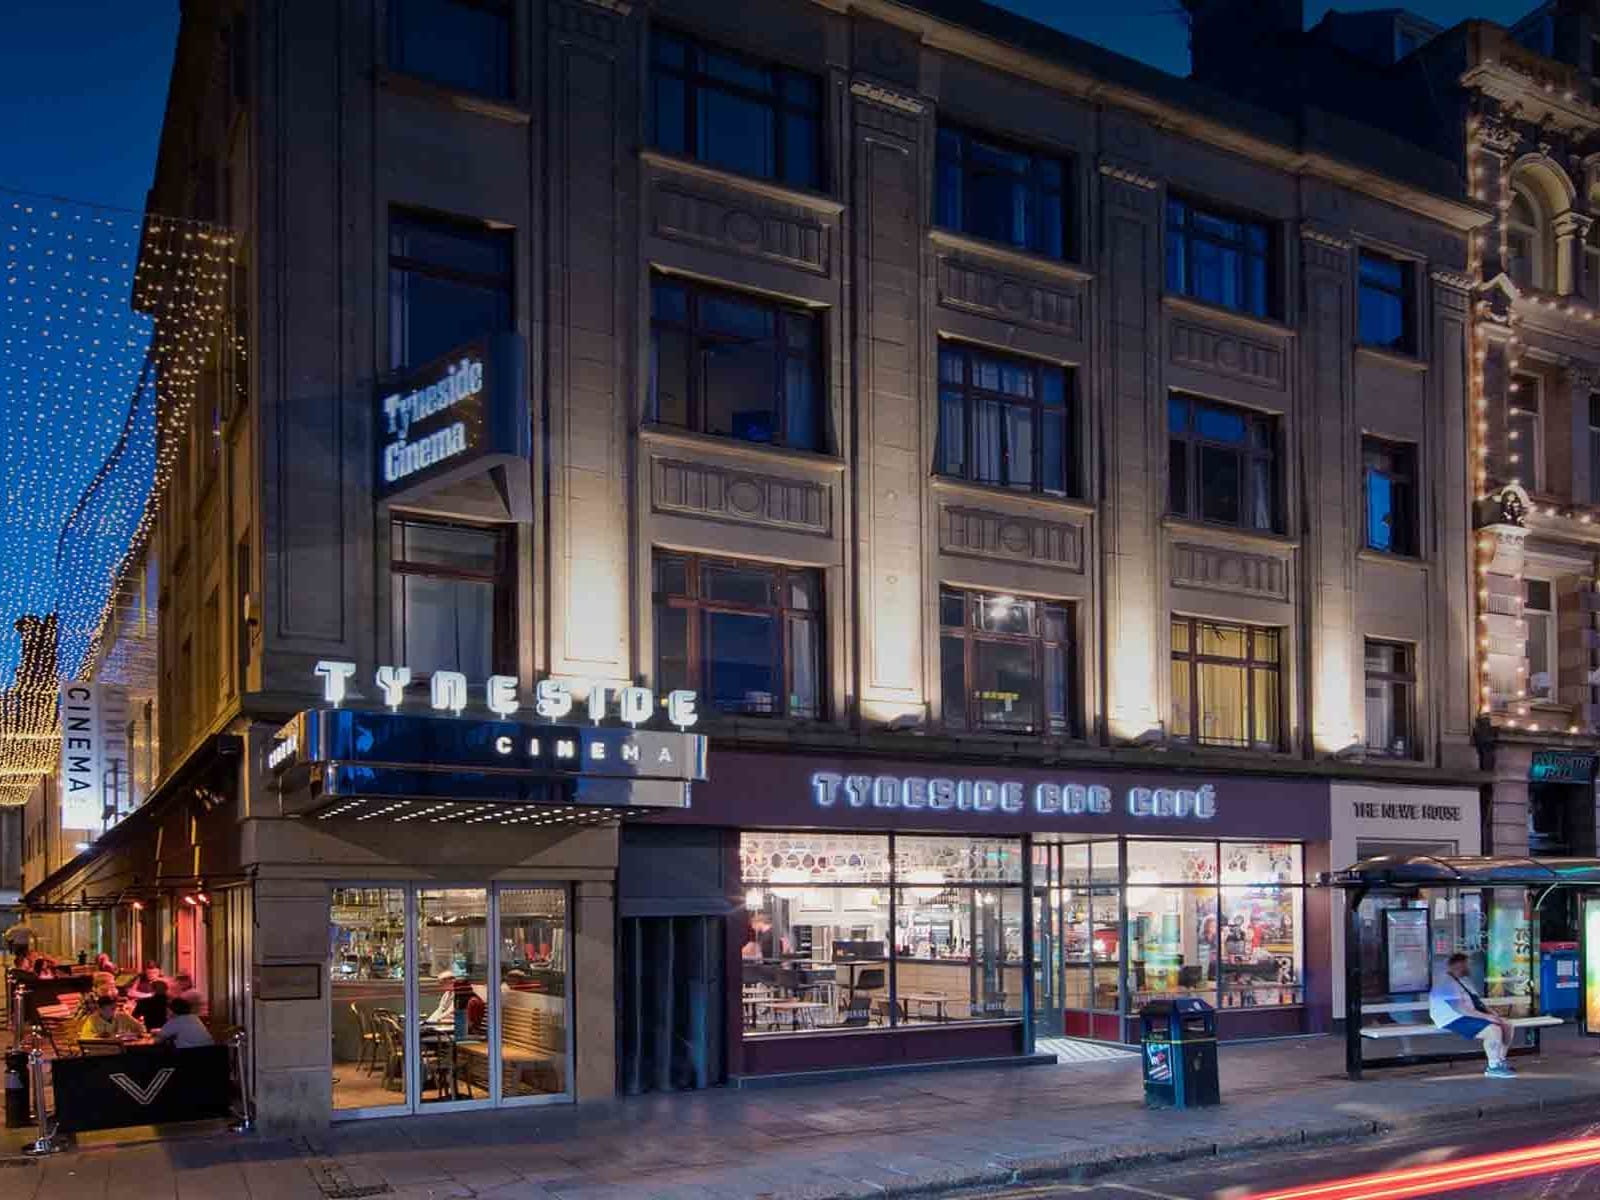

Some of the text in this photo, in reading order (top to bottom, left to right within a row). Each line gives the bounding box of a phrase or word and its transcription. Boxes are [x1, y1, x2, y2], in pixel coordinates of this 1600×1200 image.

[384, 357, 483, 439] Tyneside
[384, 421, 466, 482] Cinema
[314, 660, 699, 727] TYNESIDE
[67, 687, 91, 793] CINEMA
[495, 736, 673, 763] CINEMA
[812, 772, 1217, 818] TYNESIDE BAR CAFÉ
[1353, 802, 1379, 818] THE
